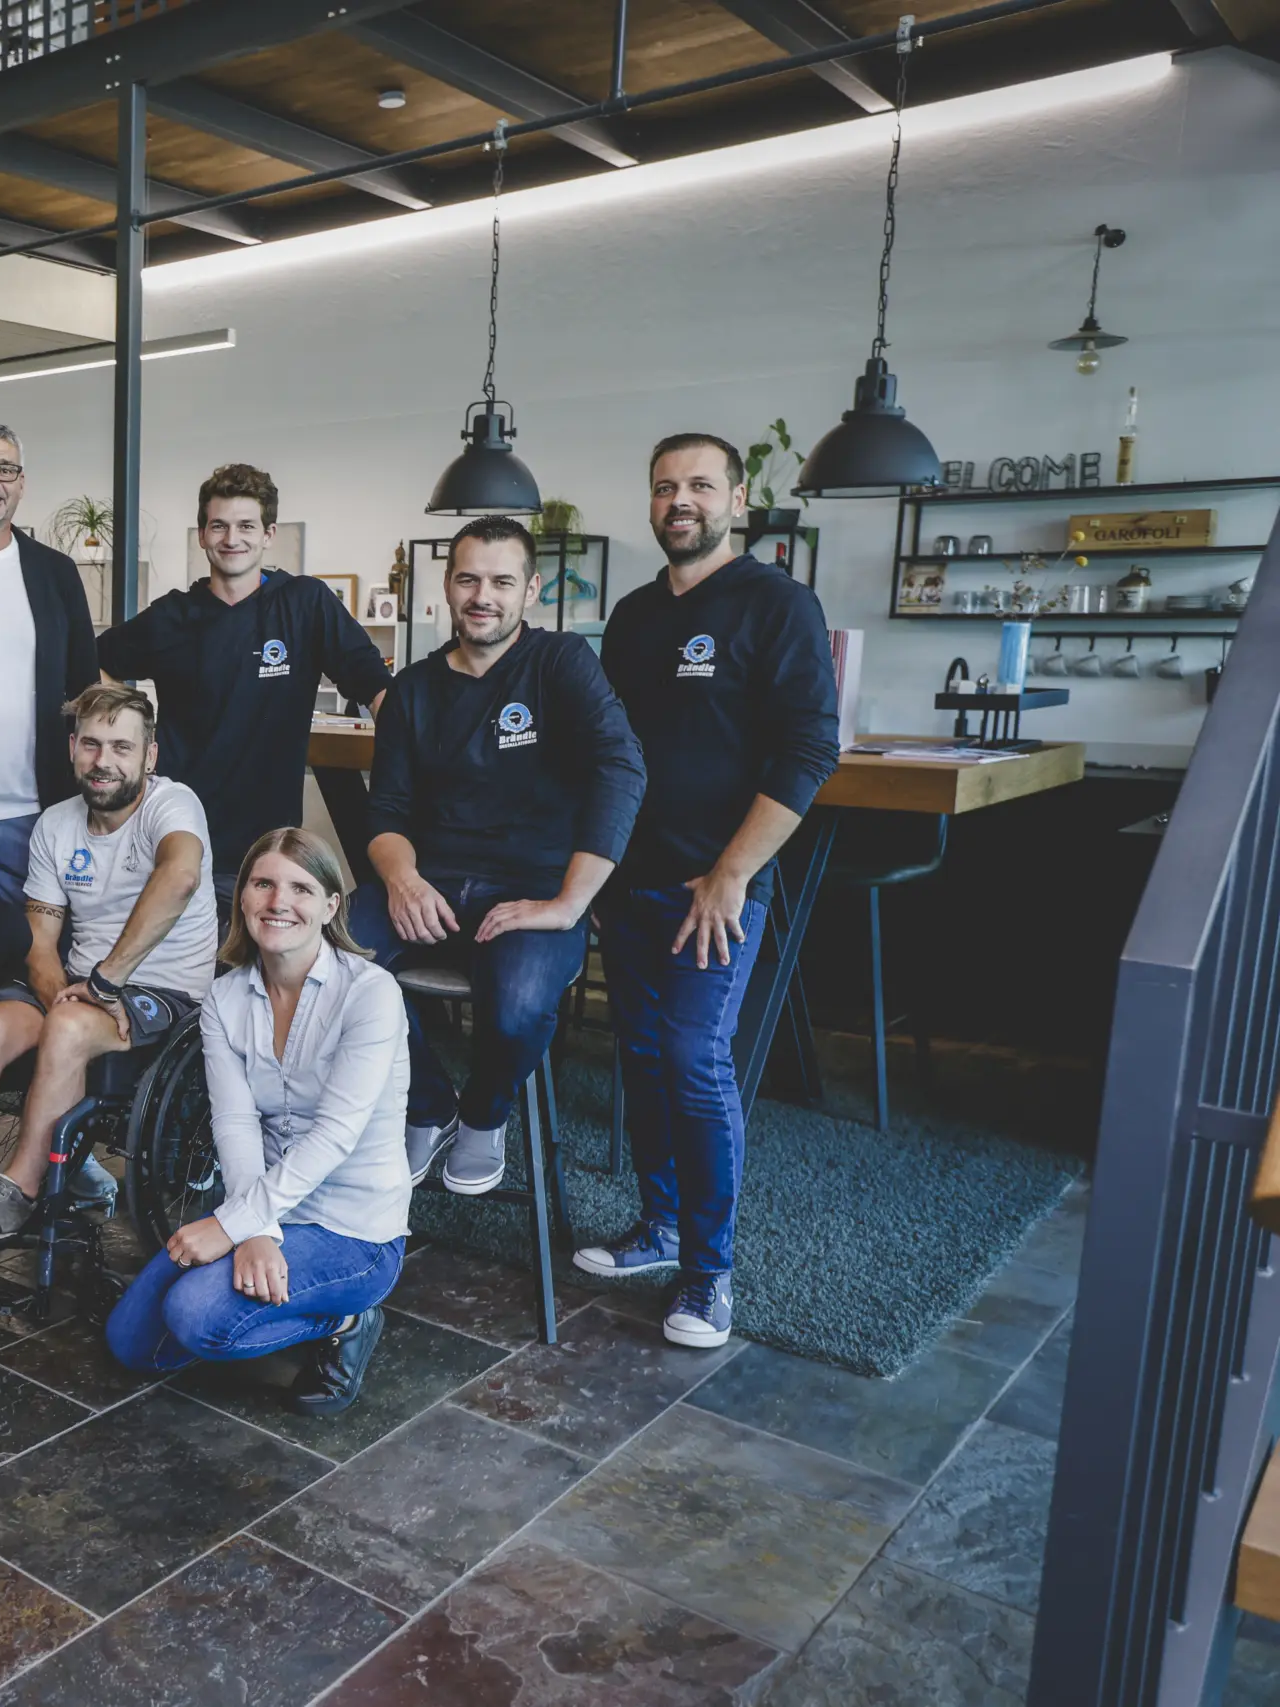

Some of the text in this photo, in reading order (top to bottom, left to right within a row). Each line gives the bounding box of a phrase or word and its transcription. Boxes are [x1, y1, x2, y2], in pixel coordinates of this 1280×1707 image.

[941, 452, 1101, 495] ELCOME
[1094, 526, 1182, 542] GAROFOLI
[498, 730, 537, 744] Brändle
[65, 873, 93, 882] Brändle
